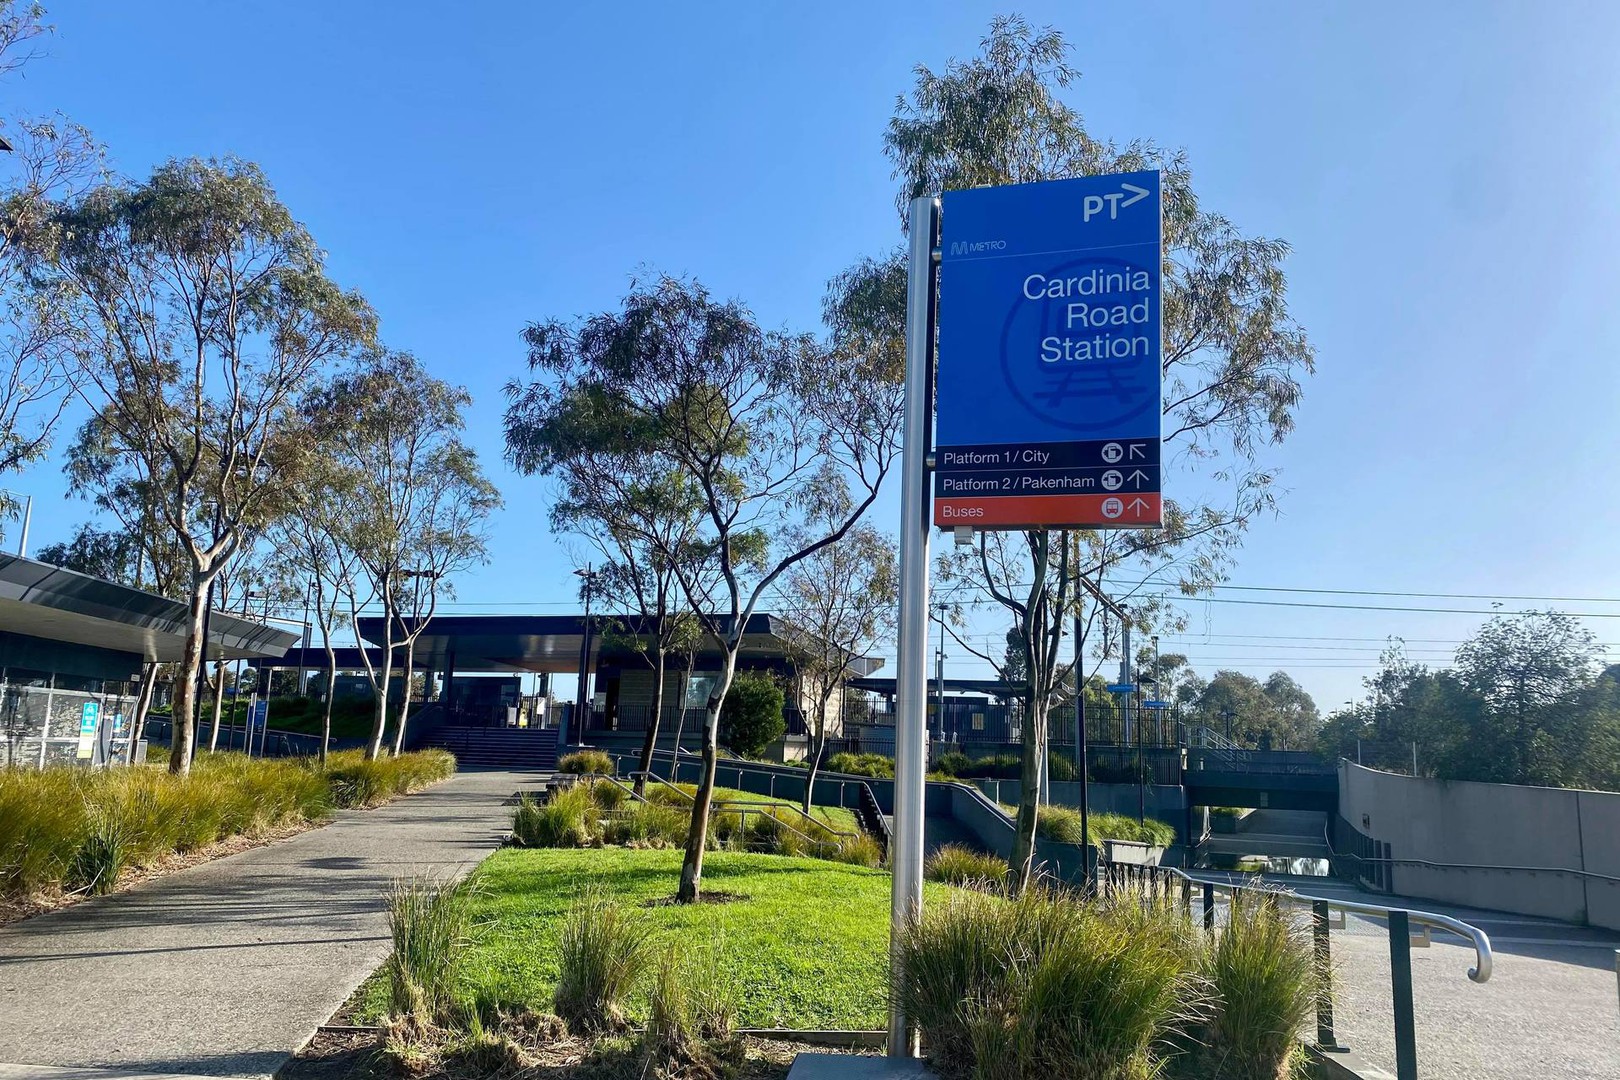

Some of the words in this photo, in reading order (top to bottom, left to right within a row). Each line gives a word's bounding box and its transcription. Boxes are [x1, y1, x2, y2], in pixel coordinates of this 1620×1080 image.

[969, 240, 1007, 252] METRO
[1023, 266, 1151, 300] Cardinia
[1067, 297, 1149, 328] Road
[1040, 333, 1149, 362] Station
[944, 452, 1000, 464] Platform
[1022, 449, 1050, 464] City
[943, 478, 999, 491] Platform
[1022, 475, 1095, 489] Pakenham
[942, 505, 984, 517] Buses
